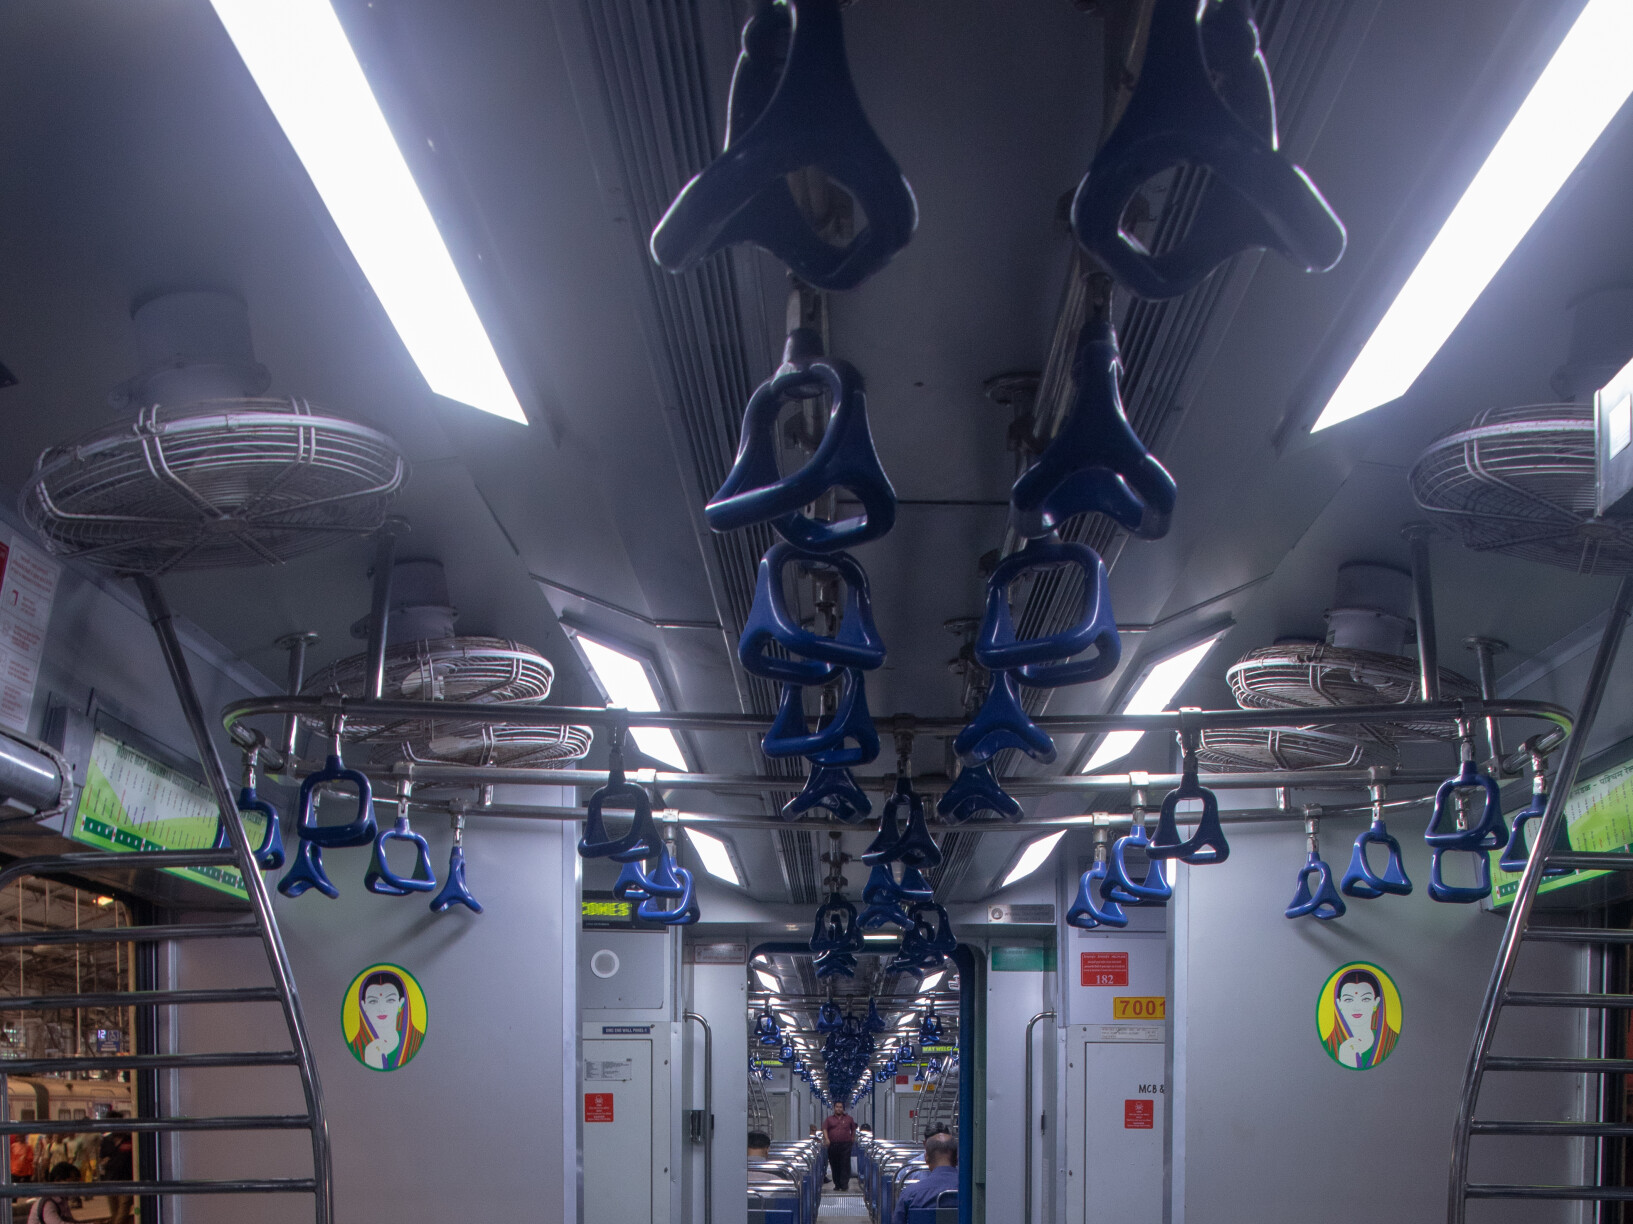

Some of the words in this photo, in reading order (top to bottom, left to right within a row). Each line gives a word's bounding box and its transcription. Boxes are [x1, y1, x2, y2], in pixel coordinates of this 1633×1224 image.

[1096, 974, 1114, 984] 182
[97, 1029, 106, 1039] 12
[1138, 1084, 1158, 1094] MCB
